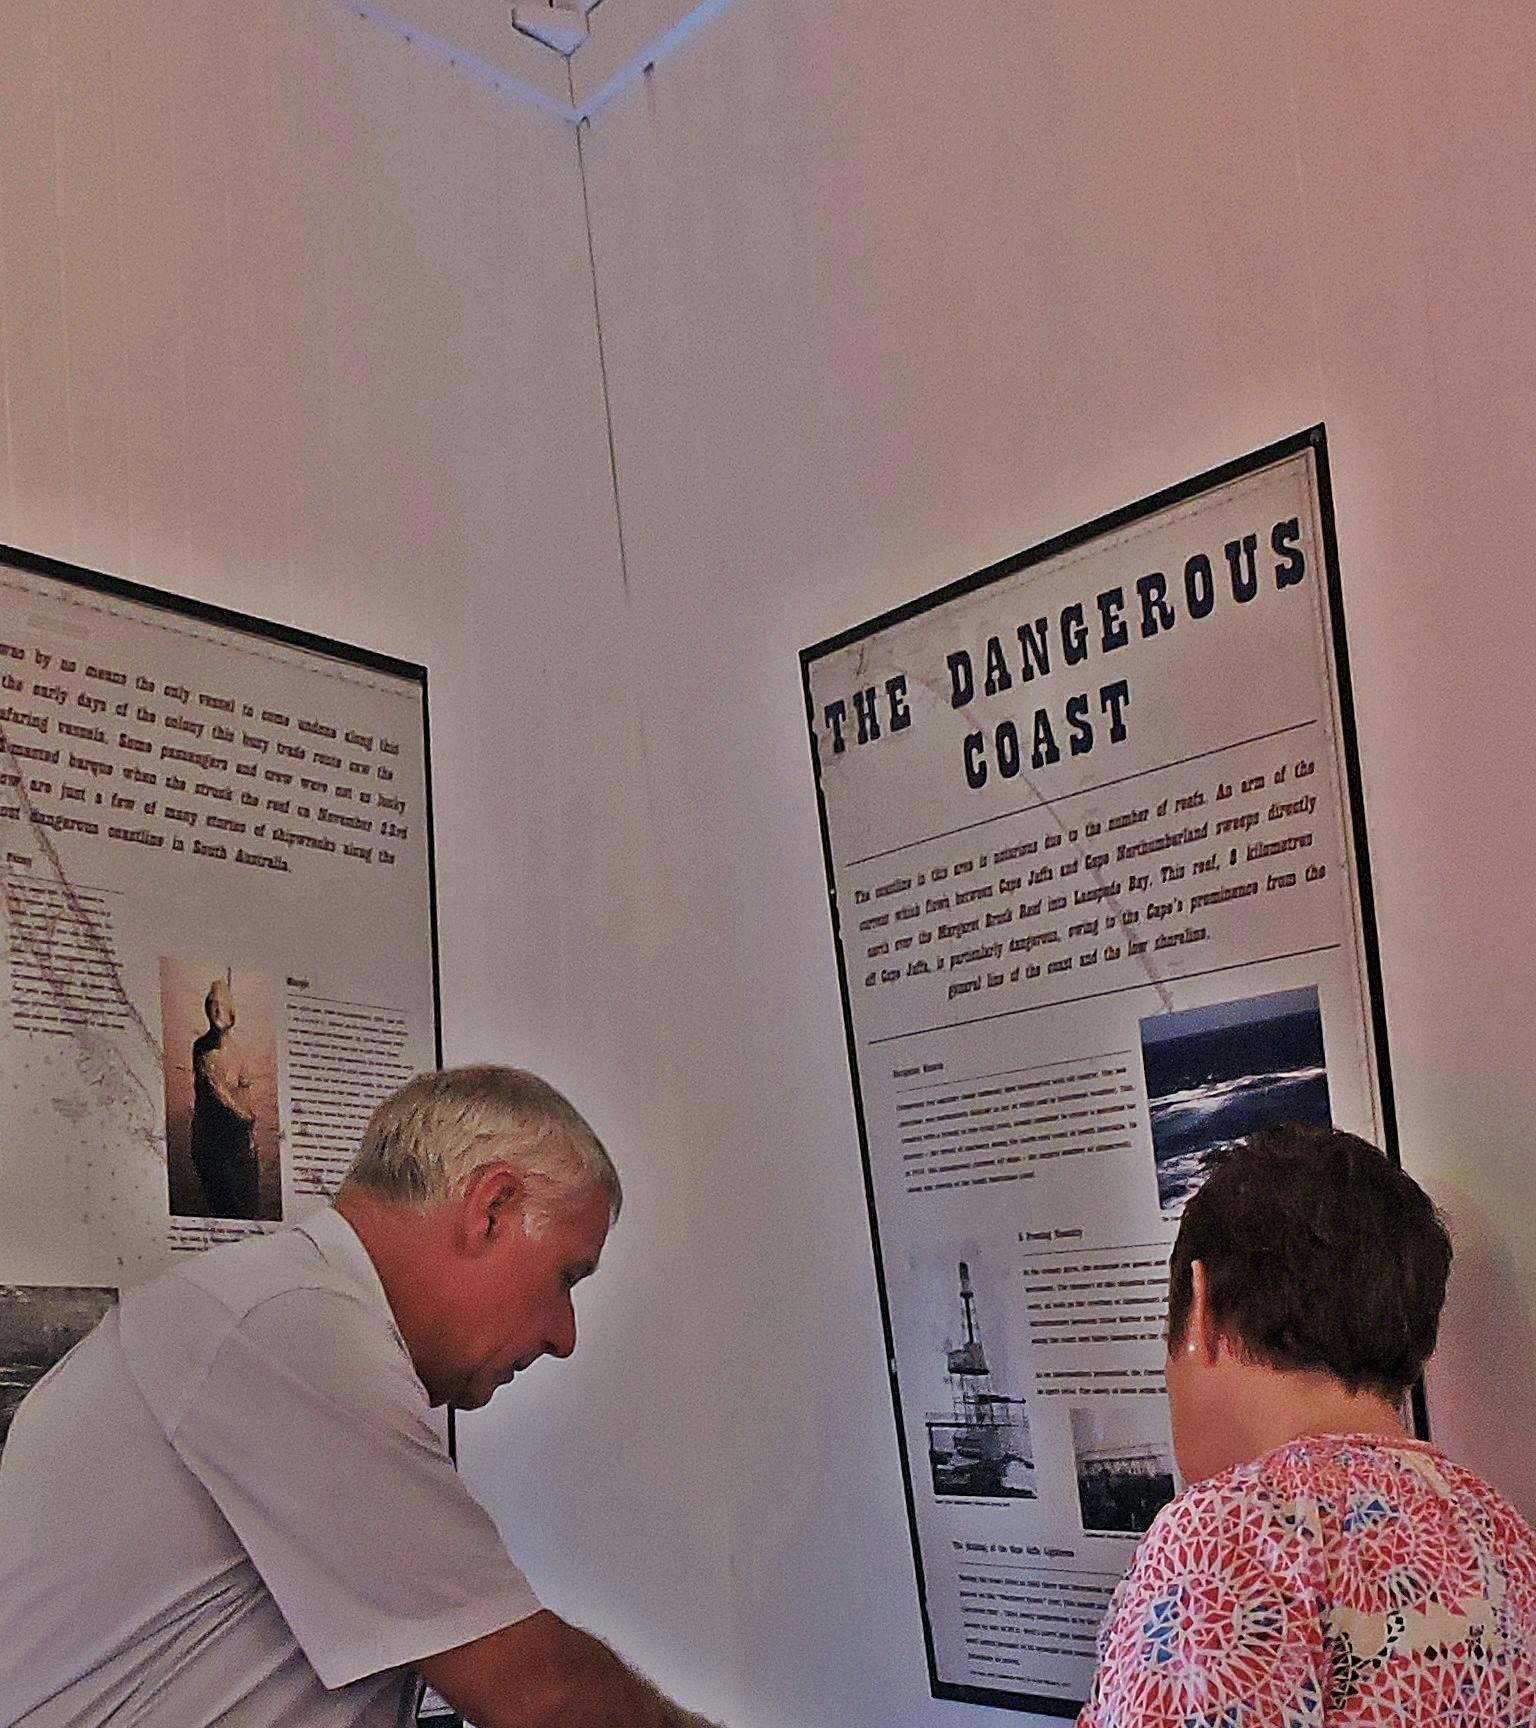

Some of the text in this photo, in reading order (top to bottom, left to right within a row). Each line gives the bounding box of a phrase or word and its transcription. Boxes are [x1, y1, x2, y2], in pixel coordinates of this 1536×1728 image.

[824, 517, 1307, 755] THE DANGEROUS
[964, 679, 1130, 790] COAST
